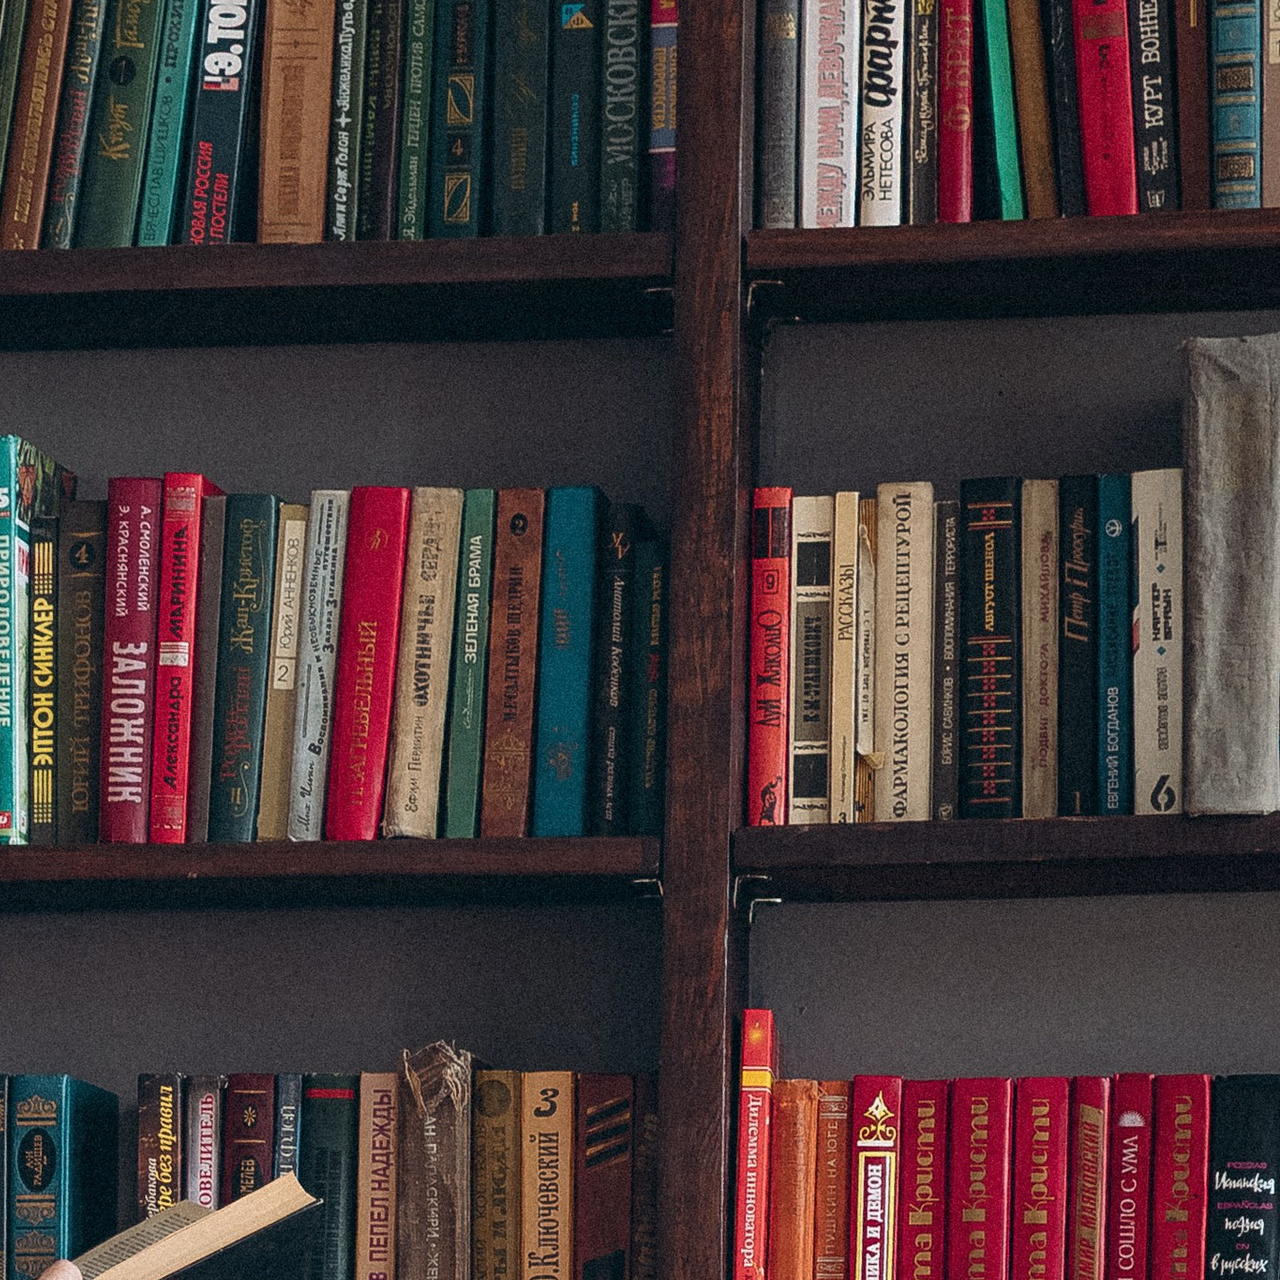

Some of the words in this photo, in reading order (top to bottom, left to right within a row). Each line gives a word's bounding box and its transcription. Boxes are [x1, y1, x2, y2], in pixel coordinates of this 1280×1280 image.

[1143, 75, 1164, 129] КУРТ
[195, 140, 213, 198] РОССИЯ
[862, 122, 876, 201] ЭЛЬМИРА
[879, 117, 894, 201] НЕТЕСОВА
[143, 167, 163, 241] ВЯЧЕСЛАВ
[210, 173, 229, 238] ПОСТЕЛИ
[115, 517, 130, 617] КРАСНЯНСКИЙ
[136, 517, 151, 611] СМОЛЕНСКИЙ
[282, 537, 300, 610] АННЕНКОВ
[466, 535, 483, 588] БРАМА
[892, 492, 913, 628] РЕЦЕПТУРОЙ
[945, 516, 956, 576] ТЕРРОРИСТА
[279, 613, 294, 650] Юрий
[464, 592, 480, 664] ЗЕЛЕНАЯ
[837, 563, 854, 642] РАССКАЗЫ
[944, 582, 955, 660] ВОСПОМИНАНИЯ
[984, 584, 995, 632] АВГУСТ
[33, 597, 54, 682] СИНКЛЕР
[72, 590, 94, 726] ТРИФОНОВ
[894, 633, 909, 646] С
[33, 686, 53, 766] ЭПТОН
[107, 641, 149, 804] ЗАЛОЖНИК
[163, 676, 183, 790] Александра
[892, 652, 909, 819] ФАРМАКОЛОГИЯ
[942, 677, 954, 730] САВИНКОВ
[1107, 686, 1120, 752] БОГДАНОВ
[69, 736, 90, 813] ЮРИЙ
[941, 732, 953, 765] БОРИС
[1106, 755, 1119, 809] ЕВГЕНИЙ
[153, 1085, 174, 1152] правил
[371, 1088, 395, 1191] НАДЕЖДЫ
[747, 1096, 763, 1169] Дилемма
[1121, 1135, 1139, 1174] УМА
[145, 1154, 173, 1183] без
[867, 1163, 883, 1223] ДЕМОН
[908, 1099, 940, 1226] Кристи
[962, 1097, 993, 1223] Кристи
[1023, 1097, 1055, 1225] Кристи
[1081, 1121, 1100, 1230] МАЯКОВСКИЙ
[1121, 1179, 1136, 1192] С
[1164, 1094, 1198, 1222] Кристи
[368, 1196, 391, 1263] ПЕПЕЛ
[743, 1171, 758, 1267] инноватора
[866, 1225, 881, 1239] И
[1118, 1199, 1135, 1271] СОШЛО
